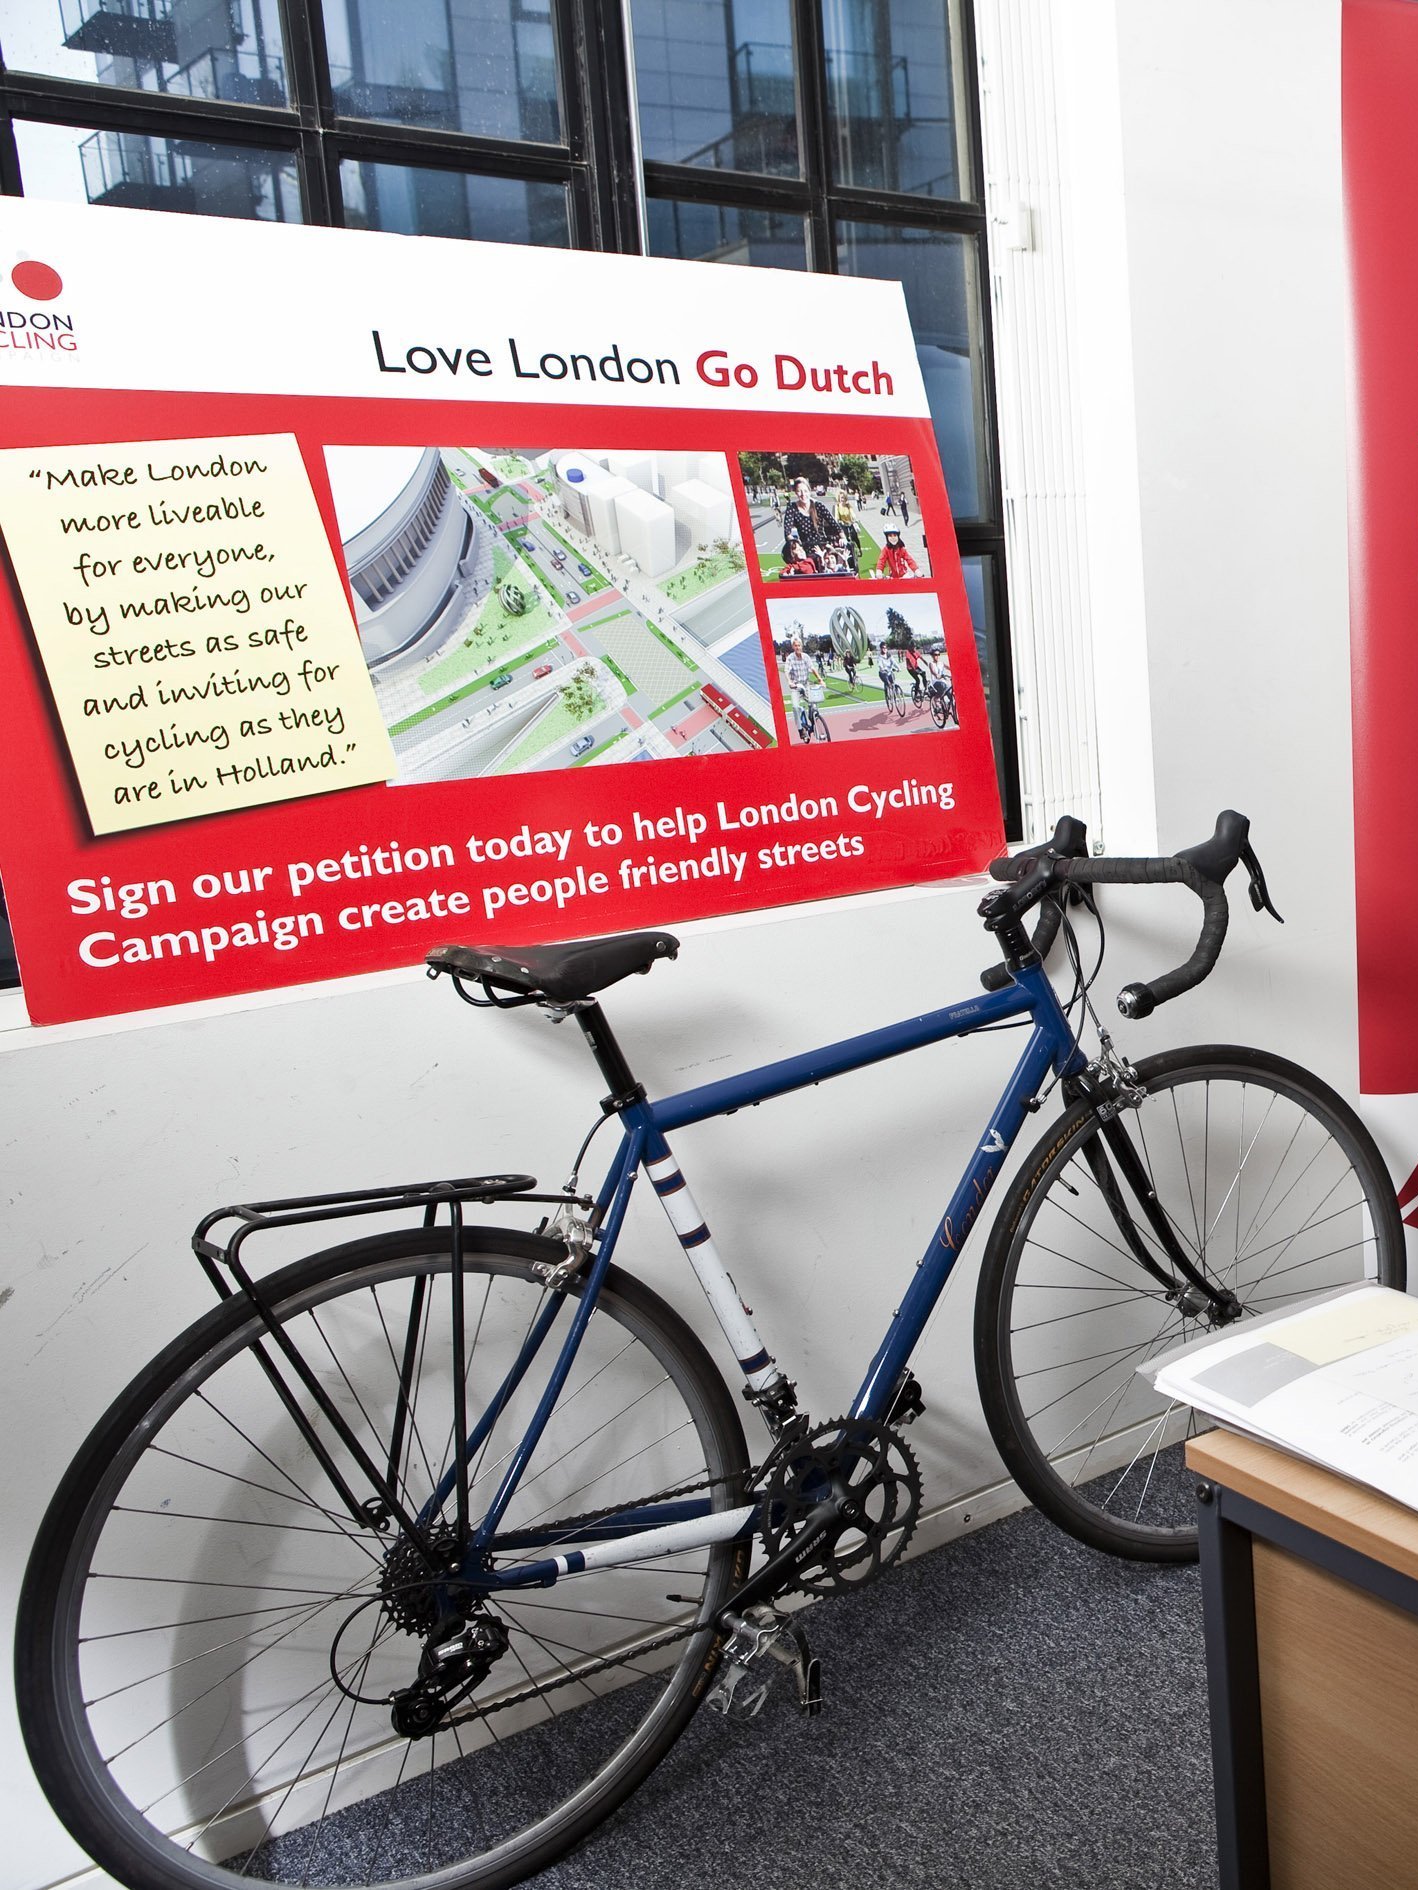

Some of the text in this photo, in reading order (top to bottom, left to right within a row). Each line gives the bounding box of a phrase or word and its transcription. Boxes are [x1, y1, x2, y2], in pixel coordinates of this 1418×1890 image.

[0, 311, 73, 331] DON
[371, 330, 894, 395] Love London Go Dutch
[148, 454, 268, 482] London
[60, 497, 266, 534] more liveable
[73, 543, 275, 587] for everyone,
[63, 582, 307, 635] by making our
[94, 619, 309, 668] streets as safe
[83, 660, 340, 717] and inviting for
[104, 706, 345, 768] cycling as they
[114, 780, 162, 804] are
[170, 769, 207, 793] in
[66, 777, 956, 919] Sign our petition today to help London Cycling
[78, 831, 864, 968] Campaign create people friendly streets
[1022, 1116, 1085, 1204] GATORSKIN
[794, 1531, 828, 1564] SRAM
